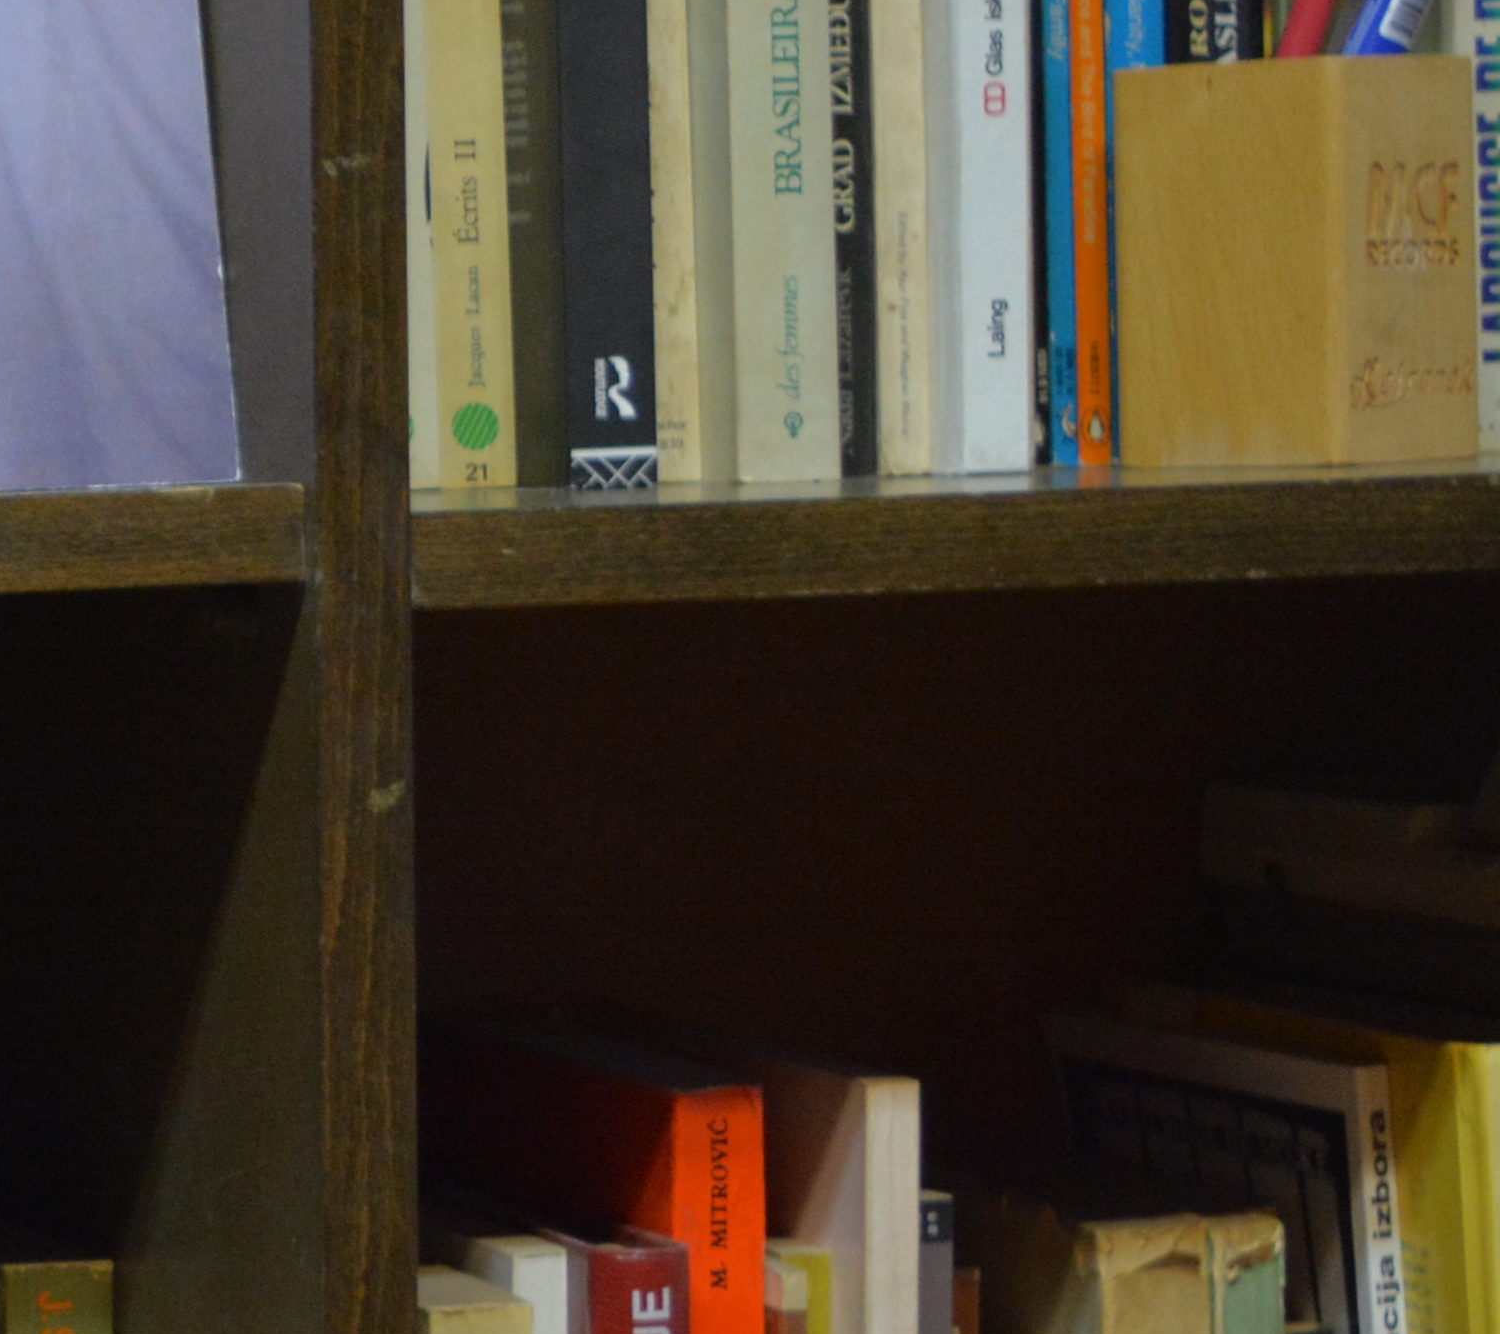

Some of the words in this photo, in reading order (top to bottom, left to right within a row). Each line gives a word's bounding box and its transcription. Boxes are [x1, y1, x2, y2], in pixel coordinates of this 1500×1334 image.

[982, 31, 1004, 78] Glas
[453, 138, 478, 163] II
[451, 174, 481, 245] Écrits
[462, 264, 482, 316] Lacan
[775, 274, 805, 357] femmes
[463, 325, 487, 388] Jacques
[983, 298, 1009, 360] Laing
[775, 363, 802, 400] des
[464, 462, 490, 483] 21
[706, 1117, 729, 1250] MITROVIĆ
[1366, 1107, 1397, 1240] izbora
